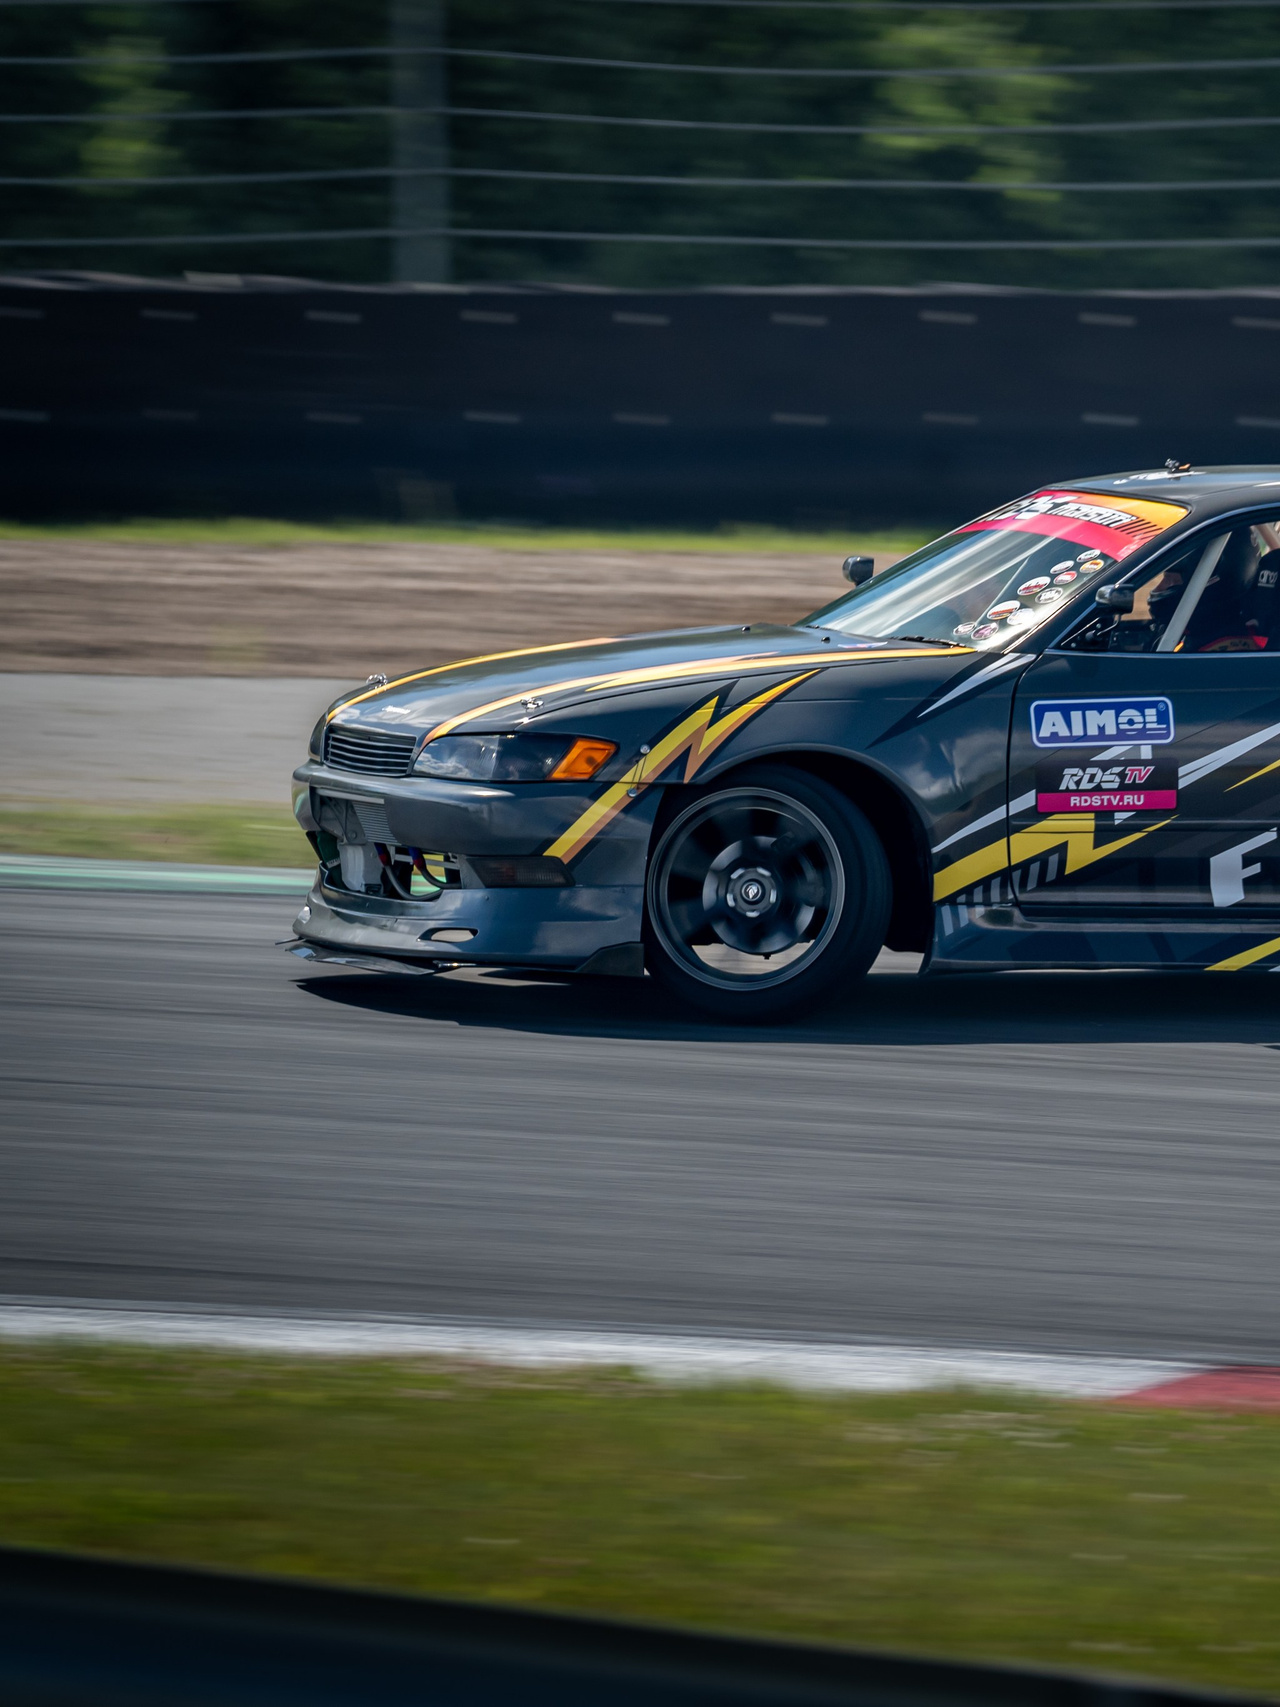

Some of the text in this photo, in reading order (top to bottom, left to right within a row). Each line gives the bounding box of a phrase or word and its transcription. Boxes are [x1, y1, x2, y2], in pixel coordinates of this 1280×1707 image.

[1038, 708, 1168, 738] AIMOL
[1058, 766, 1125, 790] RDS
[1070, 795, 1144, 807] RDSTV.RU
